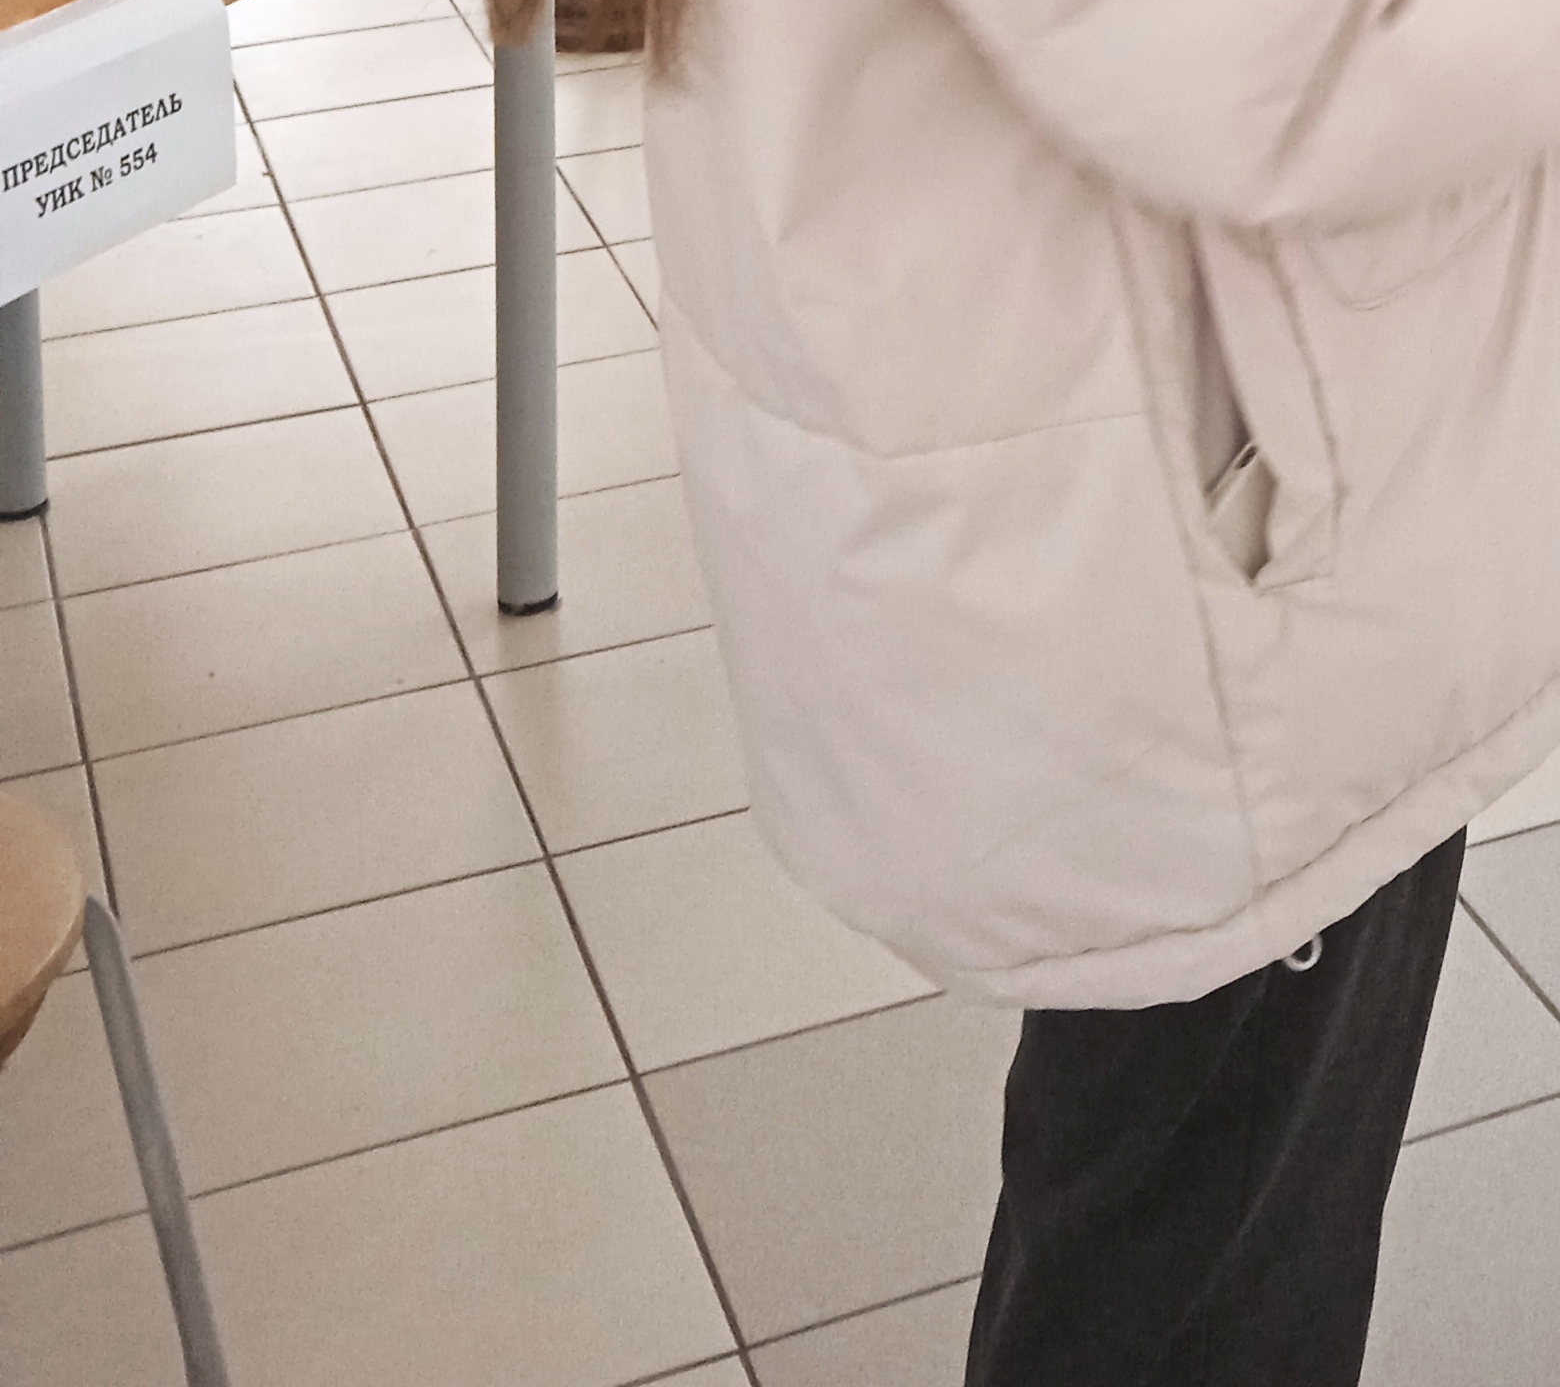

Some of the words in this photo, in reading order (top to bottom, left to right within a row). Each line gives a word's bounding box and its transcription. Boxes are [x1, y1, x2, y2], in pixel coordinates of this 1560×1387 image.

[1, 93, 183, 192] ПРЕДСЕДАТЕЛЬ
[35, 176, 85, 218] УИК
[90, 166, 113, 192] №
[120, 142, 158, 177] 554
